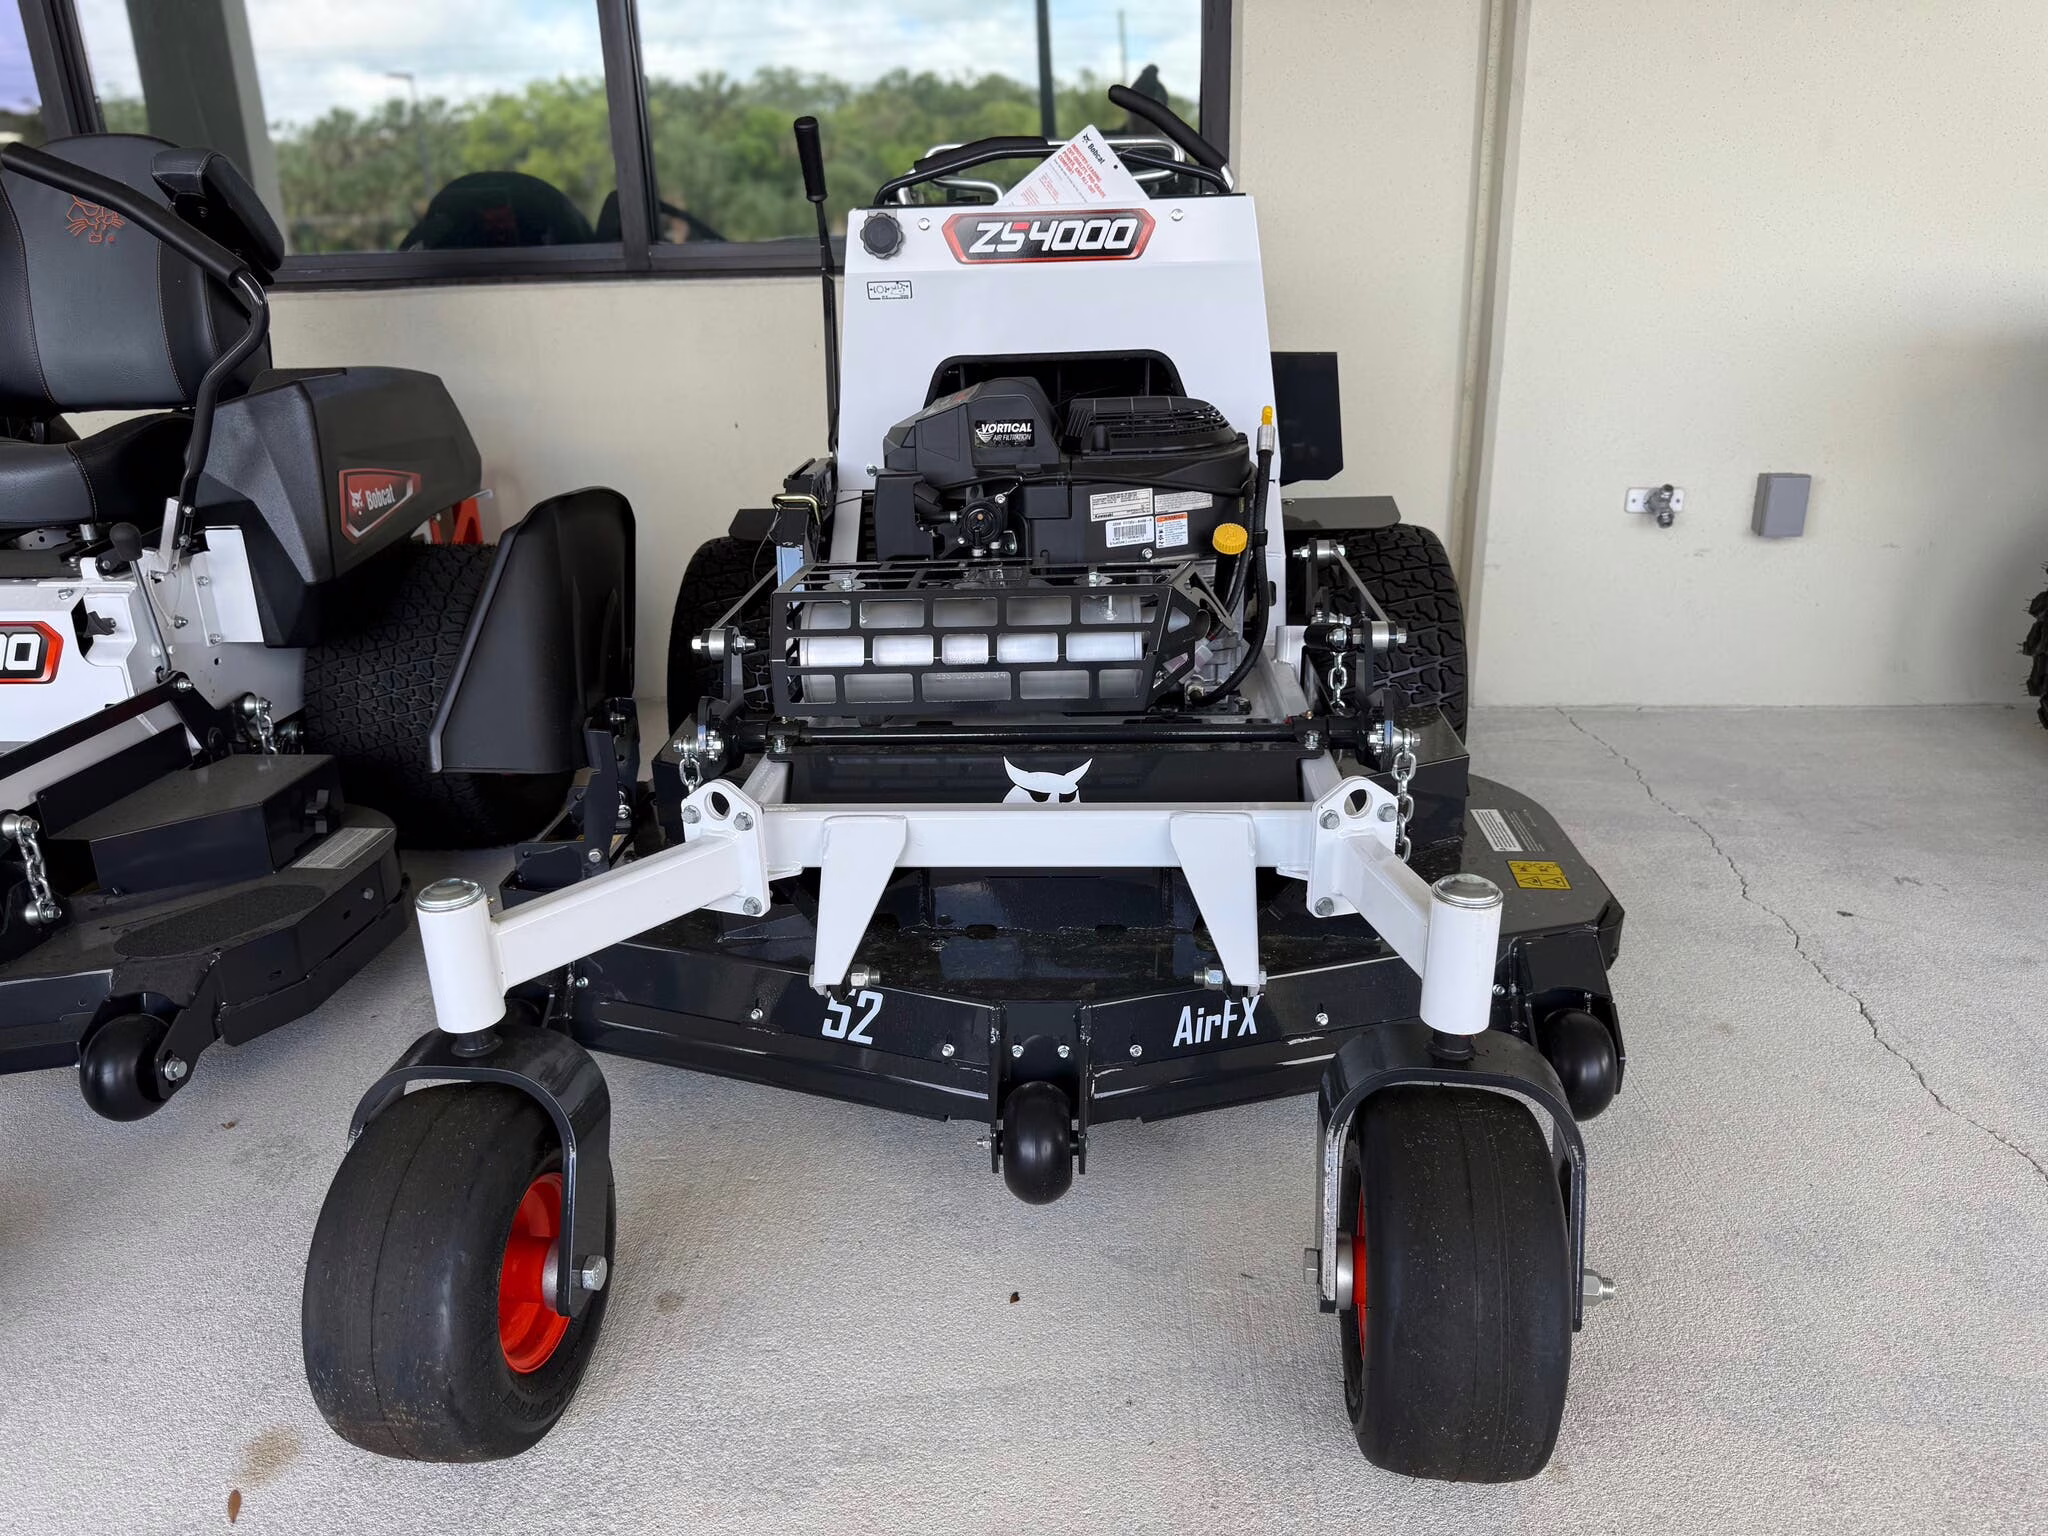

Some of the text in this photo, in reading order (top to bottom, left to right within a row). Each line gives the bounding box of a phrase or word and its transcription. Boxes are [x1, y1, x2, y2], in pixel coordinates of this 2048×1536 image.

[1087, 143, 1105, 165] Bobcat
[968, 218, 1138, 253] ZS4000
[981, 422, 1032, 433] VORTICAL
[1003, 433, 1031, 441] FILTRATION
[365, 483, 395, 511] Bobcat
[0, 633, 41, 670] 0
[822, 988, 884, 1045] 52
[1172, 993, 1264, 1047] AirFX
